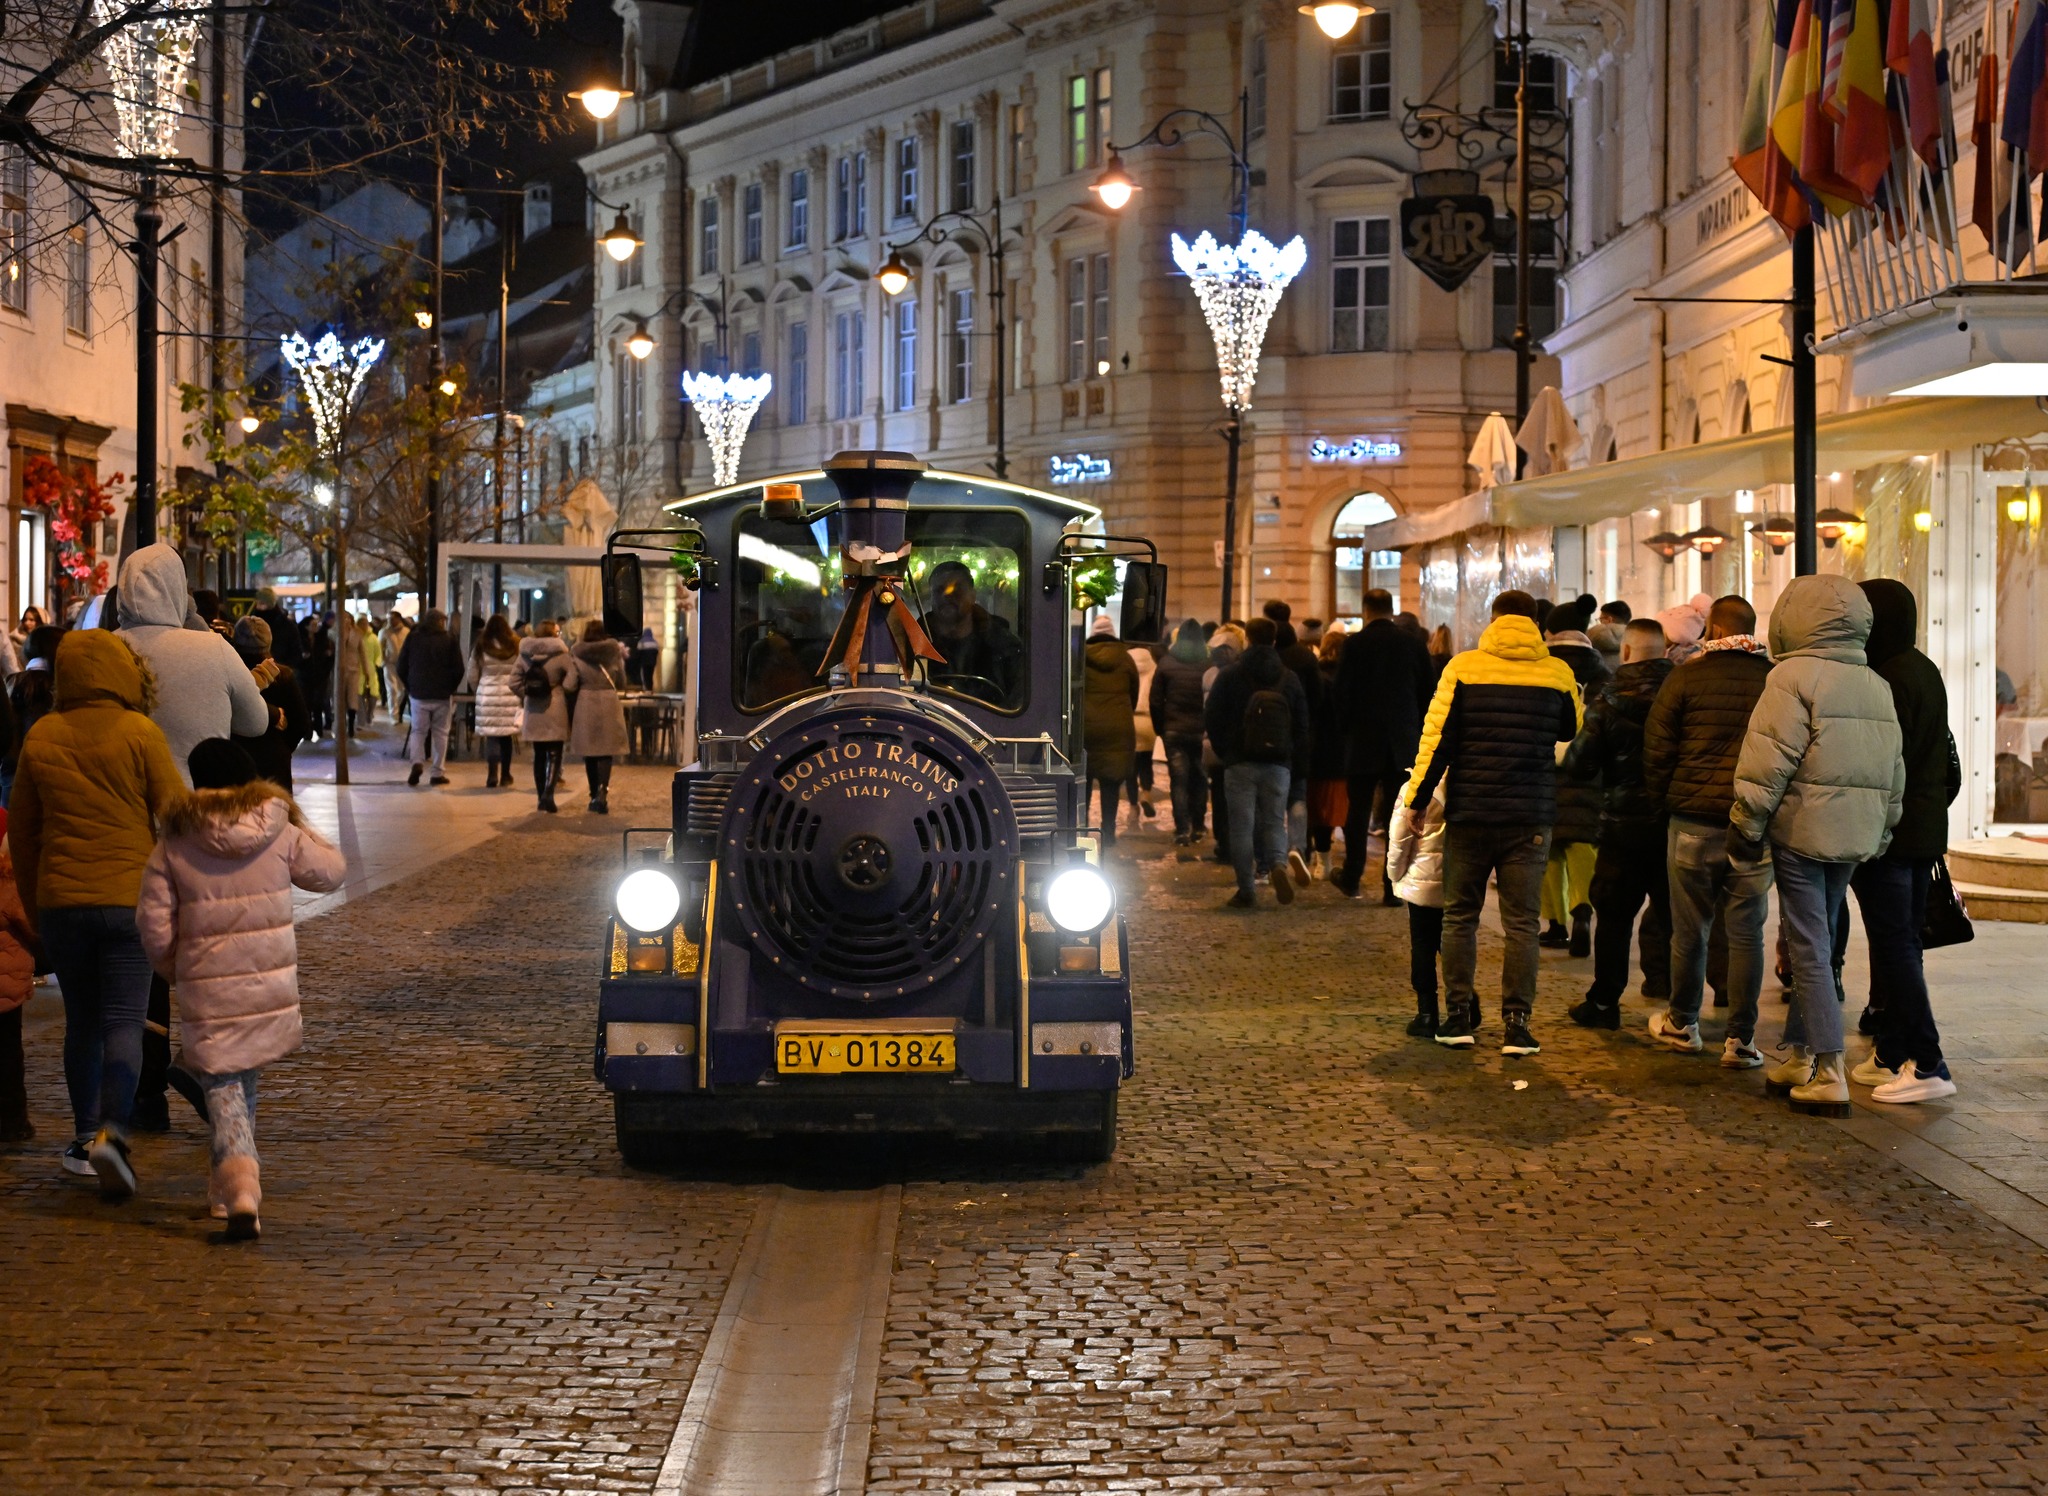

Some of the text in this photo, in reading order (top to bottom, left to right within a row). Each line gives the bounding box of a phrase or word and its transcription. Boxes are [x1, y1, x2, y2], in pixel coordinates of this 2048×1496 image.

[779, 742, 958, 793] DOTTO TRAINS
[800, 766, 924, 802] CASTELFRANCO
[845, 785, 891, 799] ITALY
[784, 1040, 945, 1068] BV 01384
